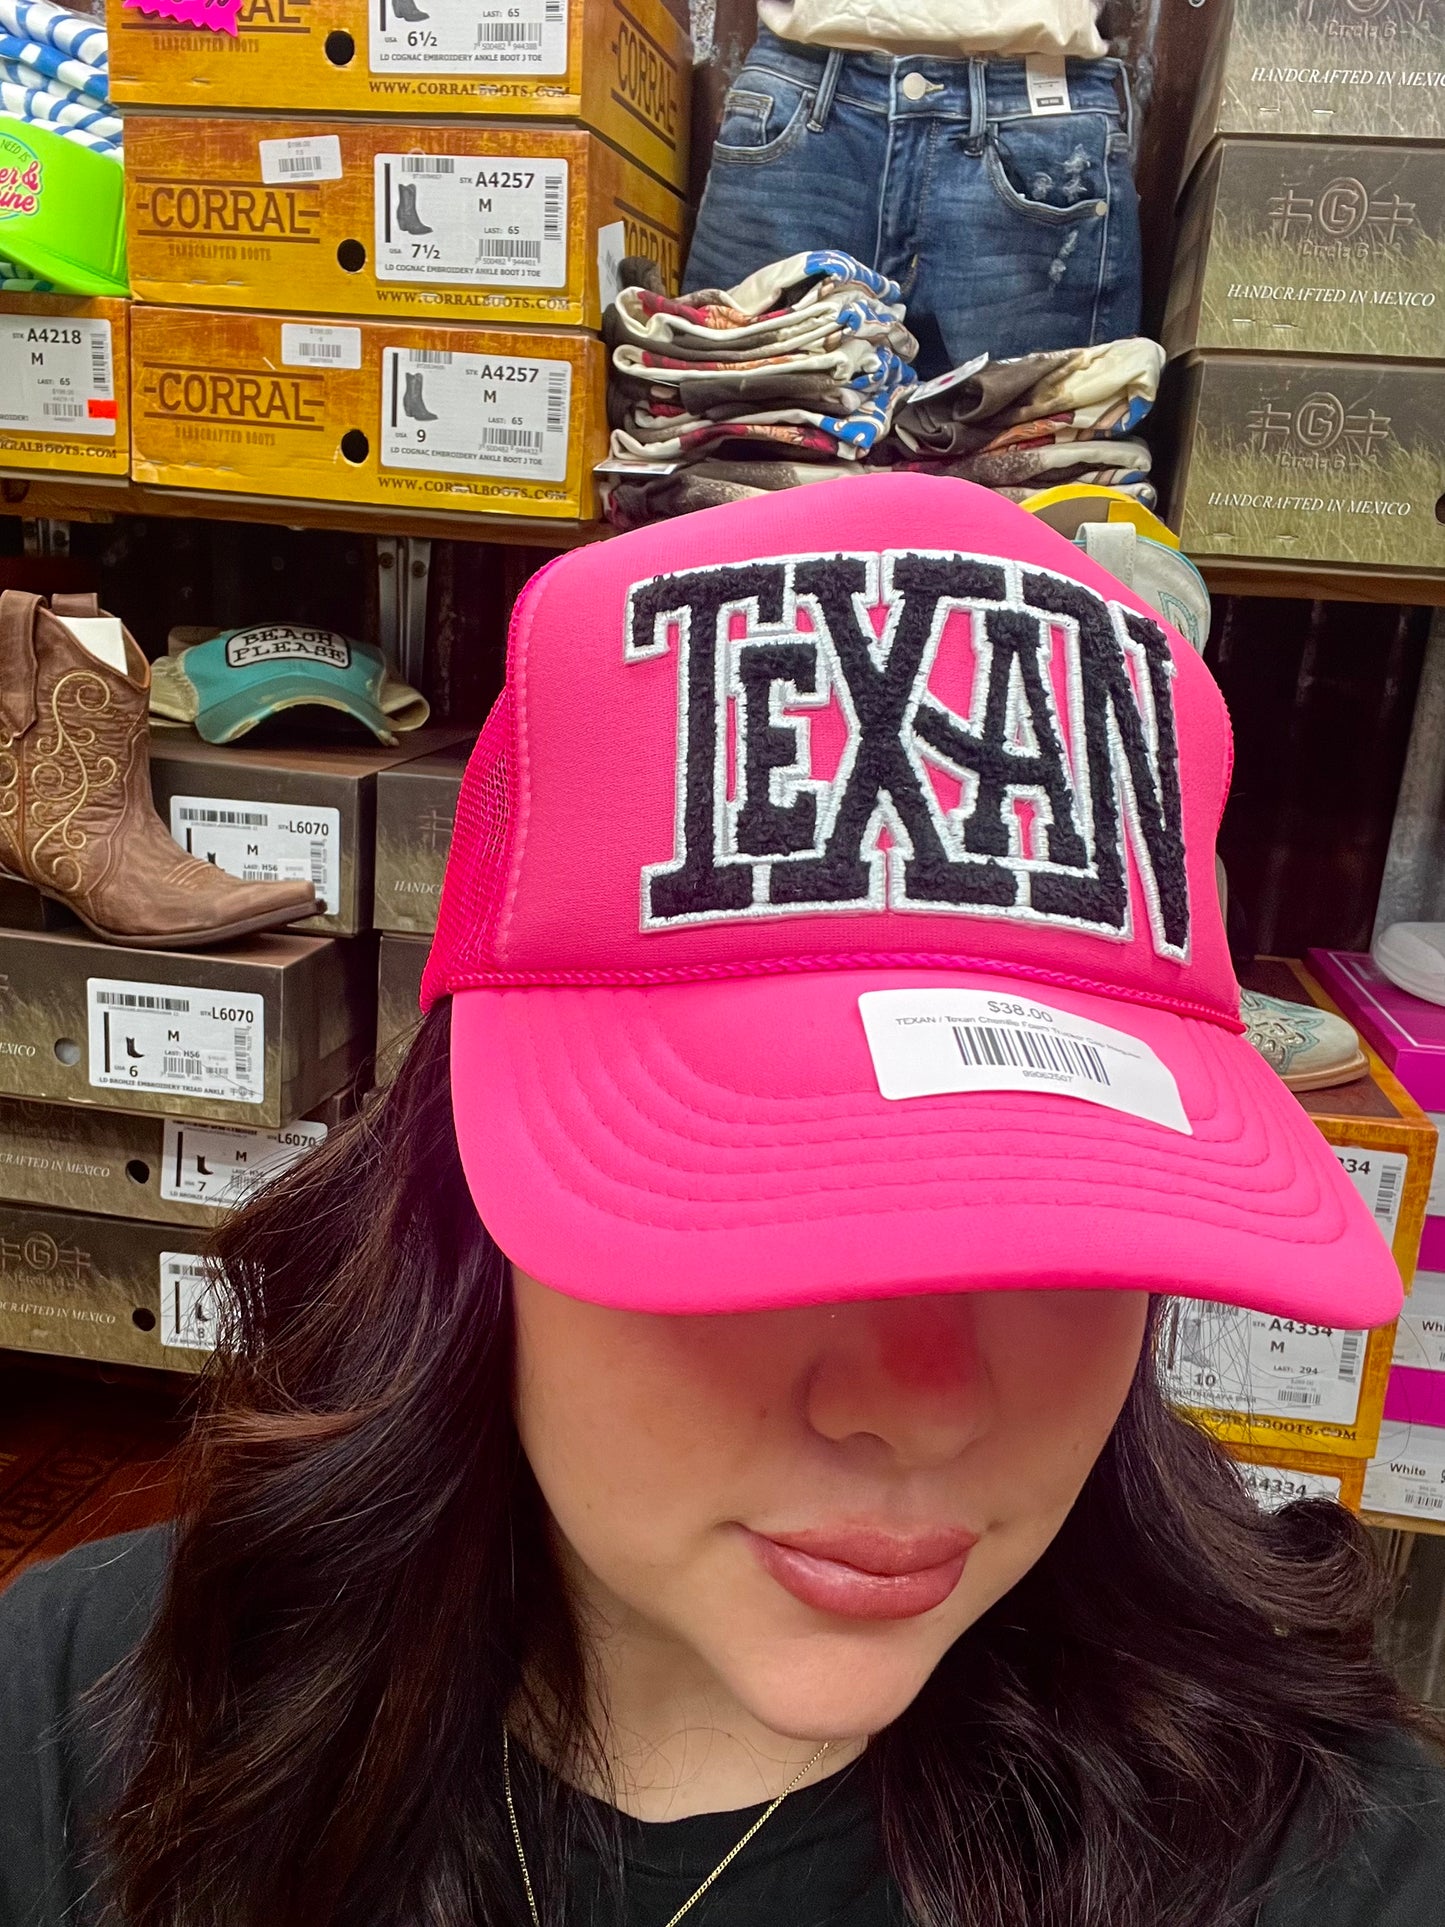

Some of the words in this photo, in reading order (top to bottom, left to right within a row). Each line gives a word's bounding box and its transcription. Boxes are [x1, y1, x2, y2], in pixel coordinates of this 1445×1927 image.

[508, 9, 520, 17] 65
[424, 54, 472, 62] EMBROIDERY
[500, 54, 520, 62] BOOT
[618, 20, 675, 136] CORRAL
[1251, 68, 1374, 85] HANDCRAFTED
[1376, 71, 1395, 85] IN
[475, 172, 534, 188] A4257
[152, 187, 310, 234] CORRAL
[479, 198, 492, 212] M
[508, 226, 520, 235] 65
[396, 264, 425, 273] COGNAC
[427, 265, 474, 274] EMBROIDERY
[500, 268, 520, 276] BOOT
[1228, 284, 1346, 302] HANDCRAFTED
[1350, 290, 1368, 304] IN
[1370, 291, 1436, 307] MEXICO
[27, 328, 81, 344] A4218
[31, 352, 43, 365] M
[480, 364, 539, 383] A4257
[158, 372, 315, 422] CORRAL
[484, 390, 496, 403] M
[511, 417, 523, 425] 65
[417, 429, 426, 442] 9
[401, 448, 429, 457] COGNAC
[432, 450, 477, 460] EMBROIDERY
[479, 454, 501, 462] ANKLE
[503, 456, 522, 464] BOOT
[1208, 492, 1324, 512] HANDCRAFTED
[1327, 499, 1345, 512] IN
[1348, 500, 1411, 516] MEXICO
[242, 627, 336, 648] BEACH
[233, 642, 346, 663] PLEASE
[624, 547, 1192, 966] TEXAN
[290, 820, 329, 836] L6070
[247, 844, 258, 856] M
[211, 1006, 254, 1023] L6070
[987, 1000, 1054, 1023] $38.00
[896, 1016, 936, 1025] TEXAN
[167, 1029, 180, 1042] M
[183, 1050, 200, 1058] H56
[129, 1065, 138, 1078] 6
[110, 1078, 135, 1086] BRONZE
[137, 1080, 180, 1090] EMBROIDERY
[204, 1087, 225, 1095] ANKLE
[278, 1134, 316, 1147] L6070
[236, 1151, 247, 1162] M
[51, 1160, 62, 1170] IN
[66, 1162, 110, 1177] MEXICO
[198, 1182, 206, 1192] 7
[57, 1308, 68, 1318] IN
[72, 1310, 116, 1324] MEXICO
[1269, 1318, 1333, 1337] A4334
[1271, 1341, 1284, 1353] M
[1300, 1366, 1318, 1374] 294
[1194, 1374, 1216, 1387] 10
[1390, 1463, 1426, 1476] White
